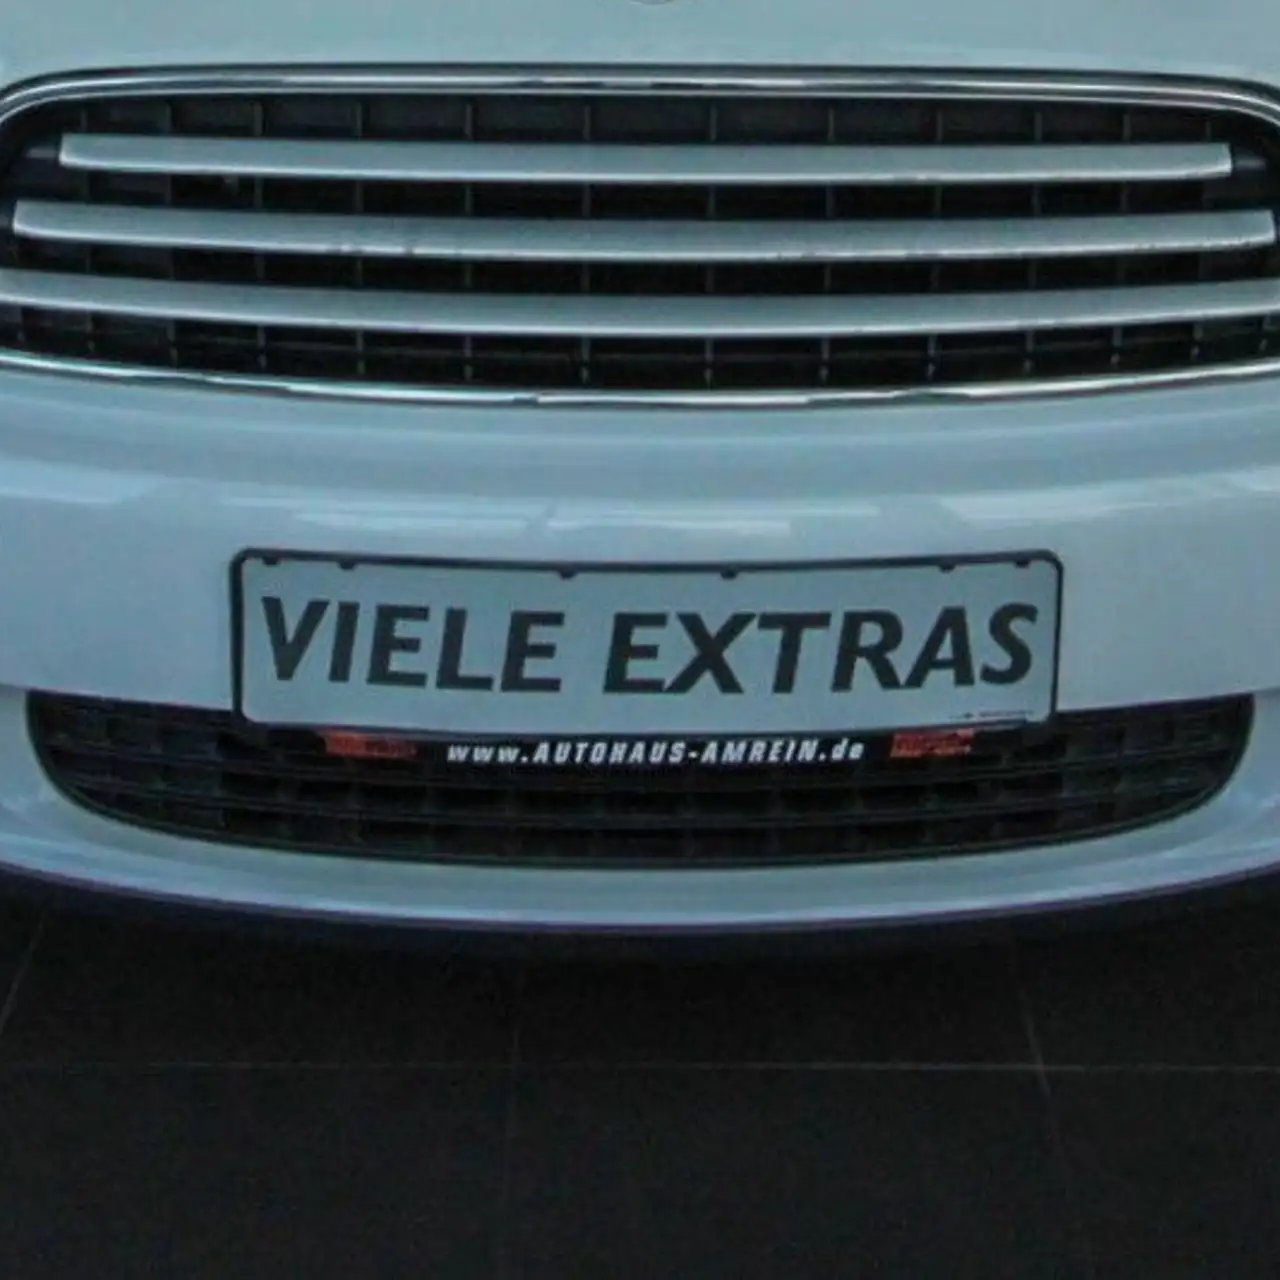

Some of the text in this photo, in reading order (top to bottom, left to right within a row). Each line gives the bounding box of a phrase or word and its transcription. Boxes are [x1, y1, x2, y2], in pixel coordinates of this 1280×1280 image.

[261, 596, 1039, 695] VIELE EXTRAS
[446, 737, 866, 765] www.AUTOHAUS-AMREIN.de
